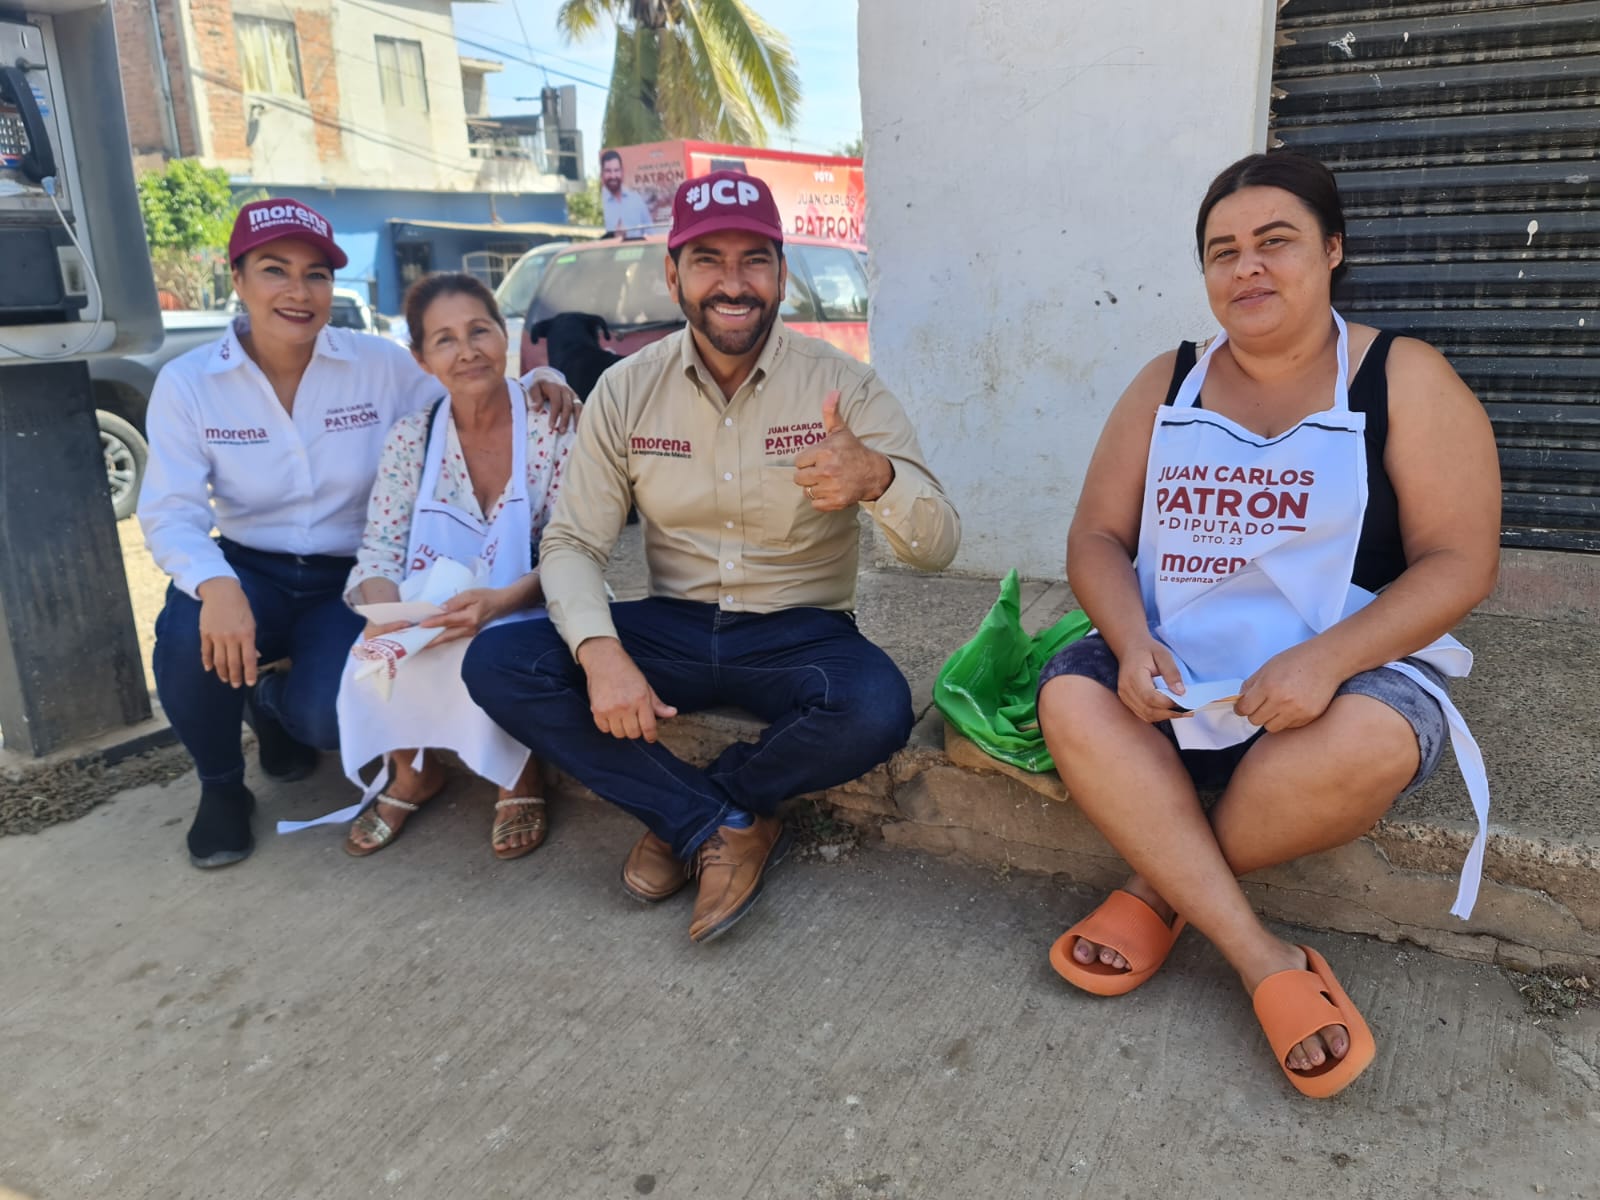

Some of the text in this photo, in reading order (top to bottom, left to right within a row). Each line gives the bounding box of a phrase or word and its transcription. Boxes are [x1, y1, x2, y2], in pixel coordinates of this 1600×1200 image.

[686, 179, 760, 211] #JCP
[798, 192, 856, 208] JUAN CARLOS
[248, 205, 328, 232] morena
[324, 409, 379, 428] PATRÓN
[205, 428, 268, 440] morena
[768, 422, 823, 435] JUAN CARLOS
[631, 437, 691, 452] morena
[765, 430, 827, 450] PATRÓN
[777, 446, 805, 455] DIPUT
[1158, 465, 1315, 486] JUAN CARLOS
[1157, 486, 1309, 519] PATRÓN
[1168, 517, 1275, 535] DIPUTADO
[1193, 534, 1243, 546] DTTO. 23
[1161, 553, 1247, 575] moren
[1160, 574, 1168, 582] La
[1170, 576, 1214, 584] esperanza
